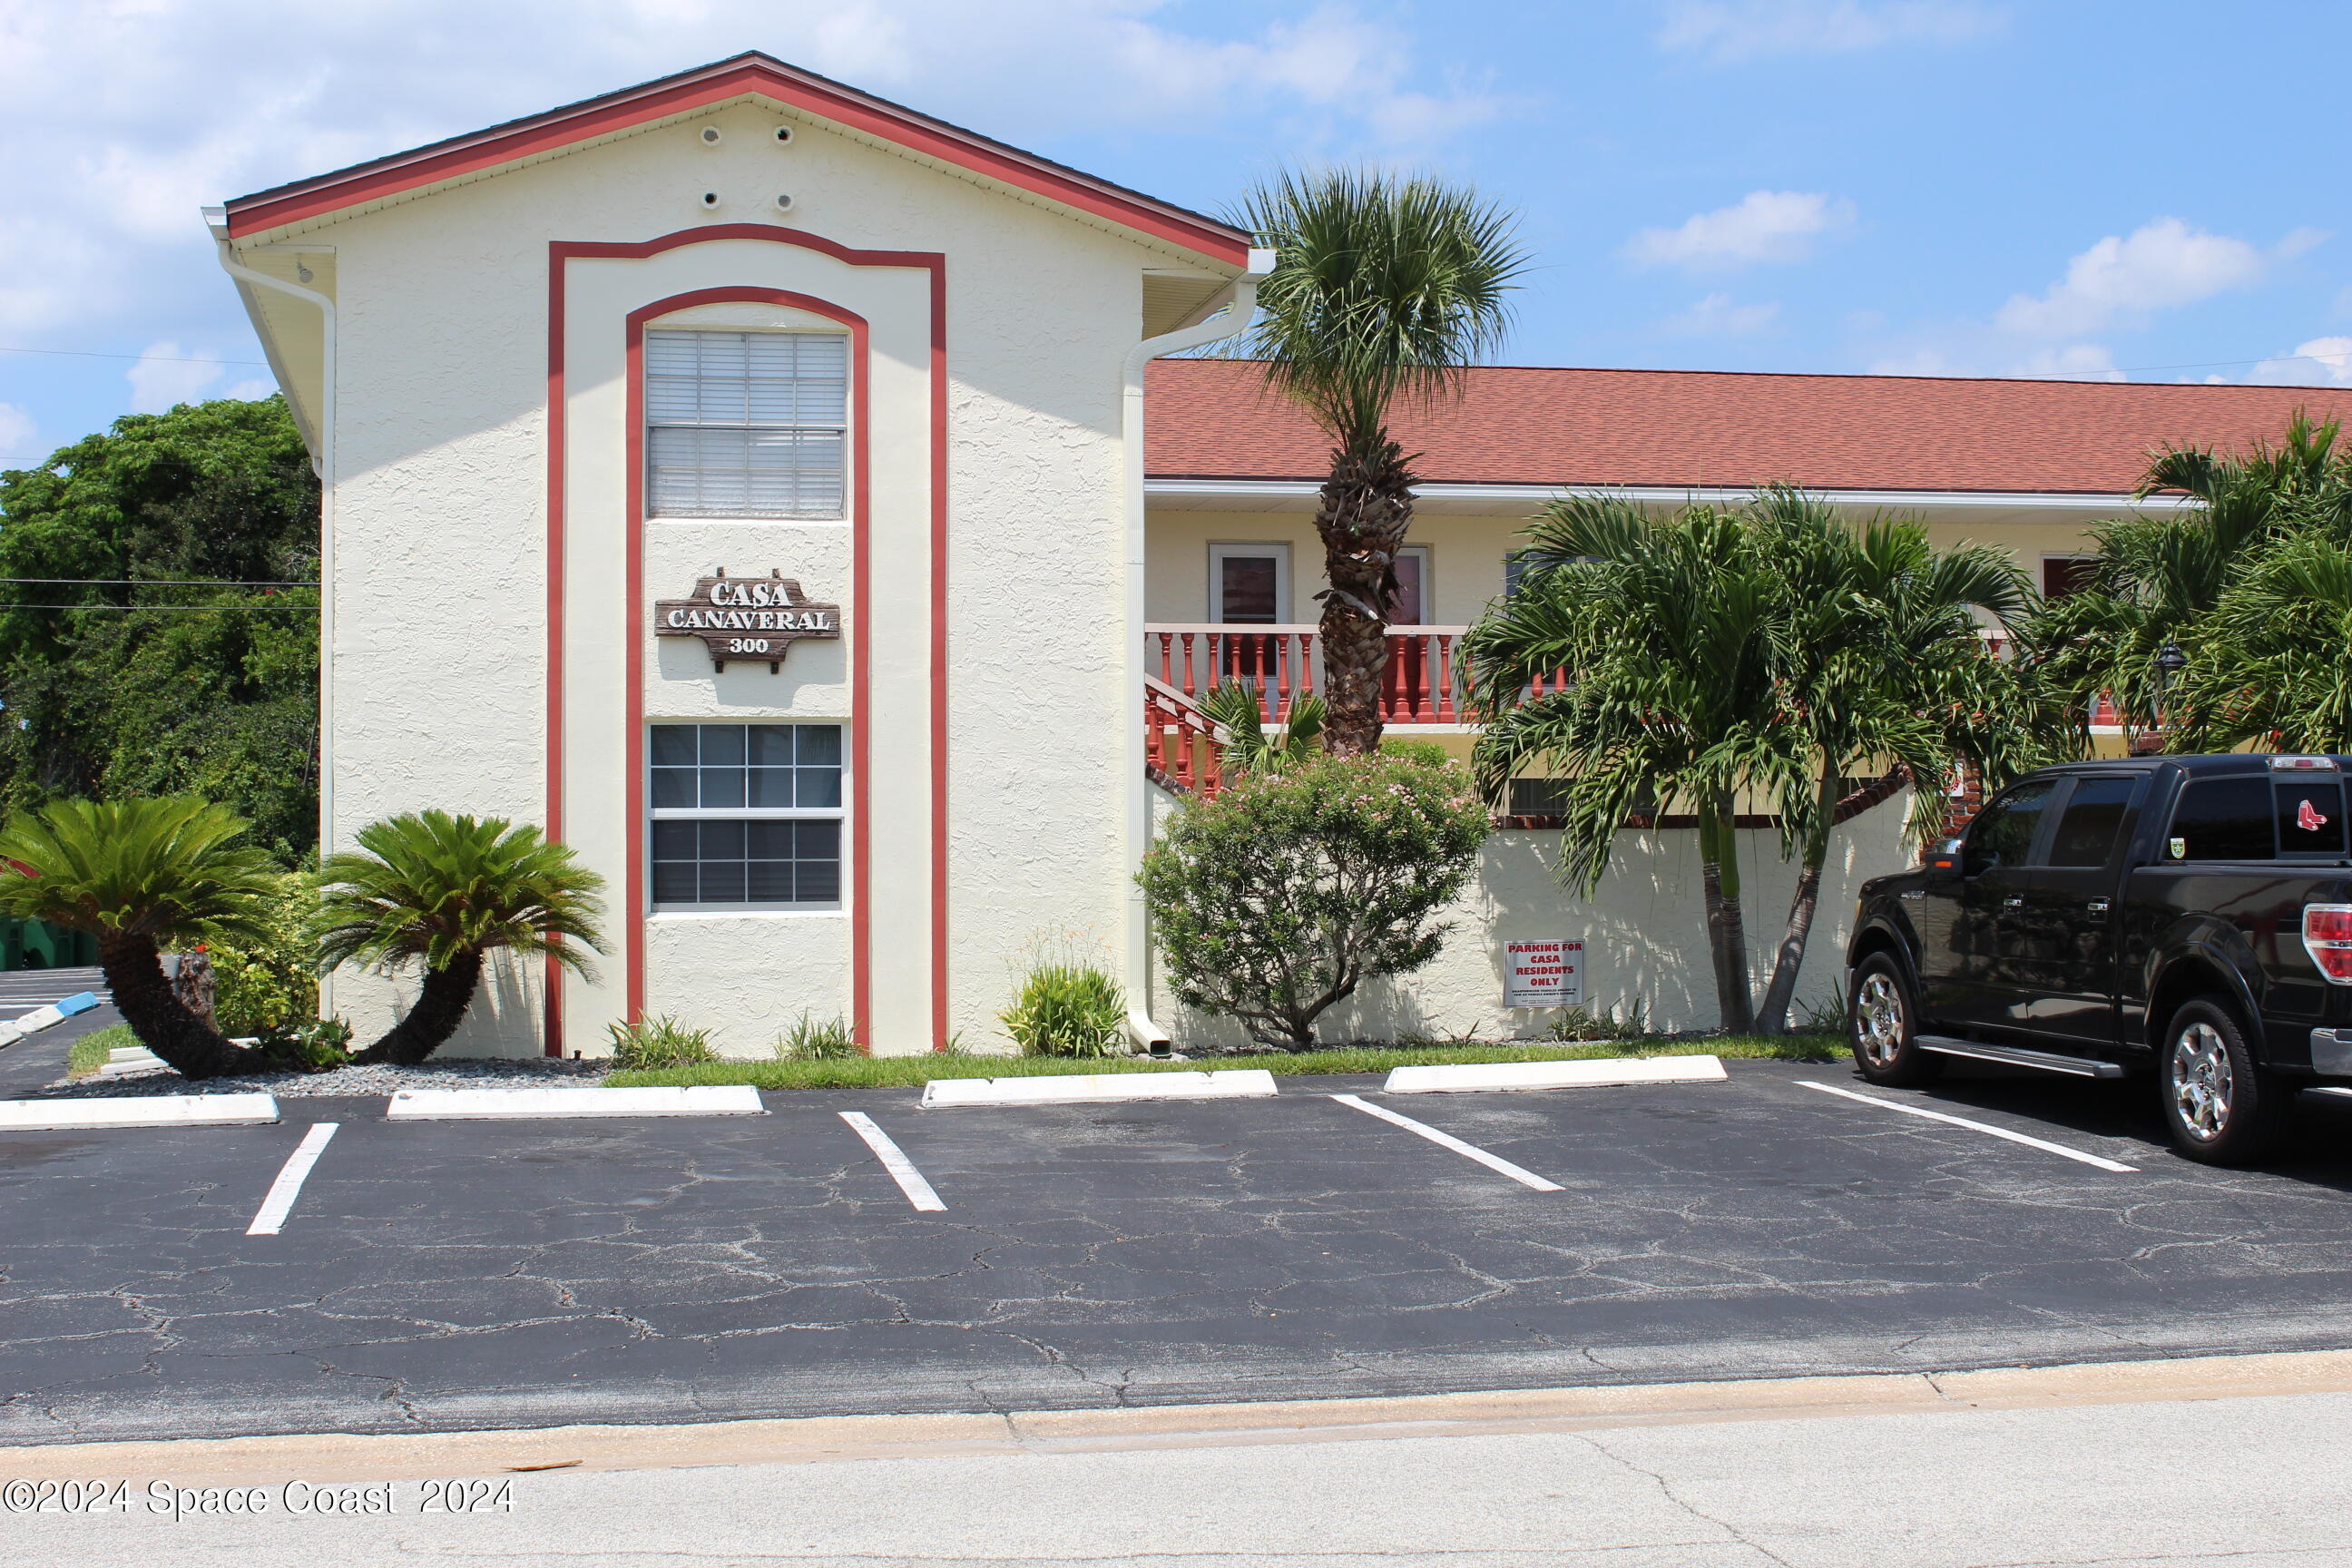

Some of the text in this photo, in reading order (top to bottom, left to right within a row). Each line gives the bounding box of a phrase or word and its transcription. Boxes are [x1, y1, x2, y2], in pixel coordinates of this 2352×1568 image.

[710, 581, 793, 609] CASA
[668, 609, 830, 631] CANAVERAL
[730, 638, 769, 653] 300
[1508, 943, 1583, 952] PARKING FOR
[1516, 966, 1573, 975] RESIDENTS
